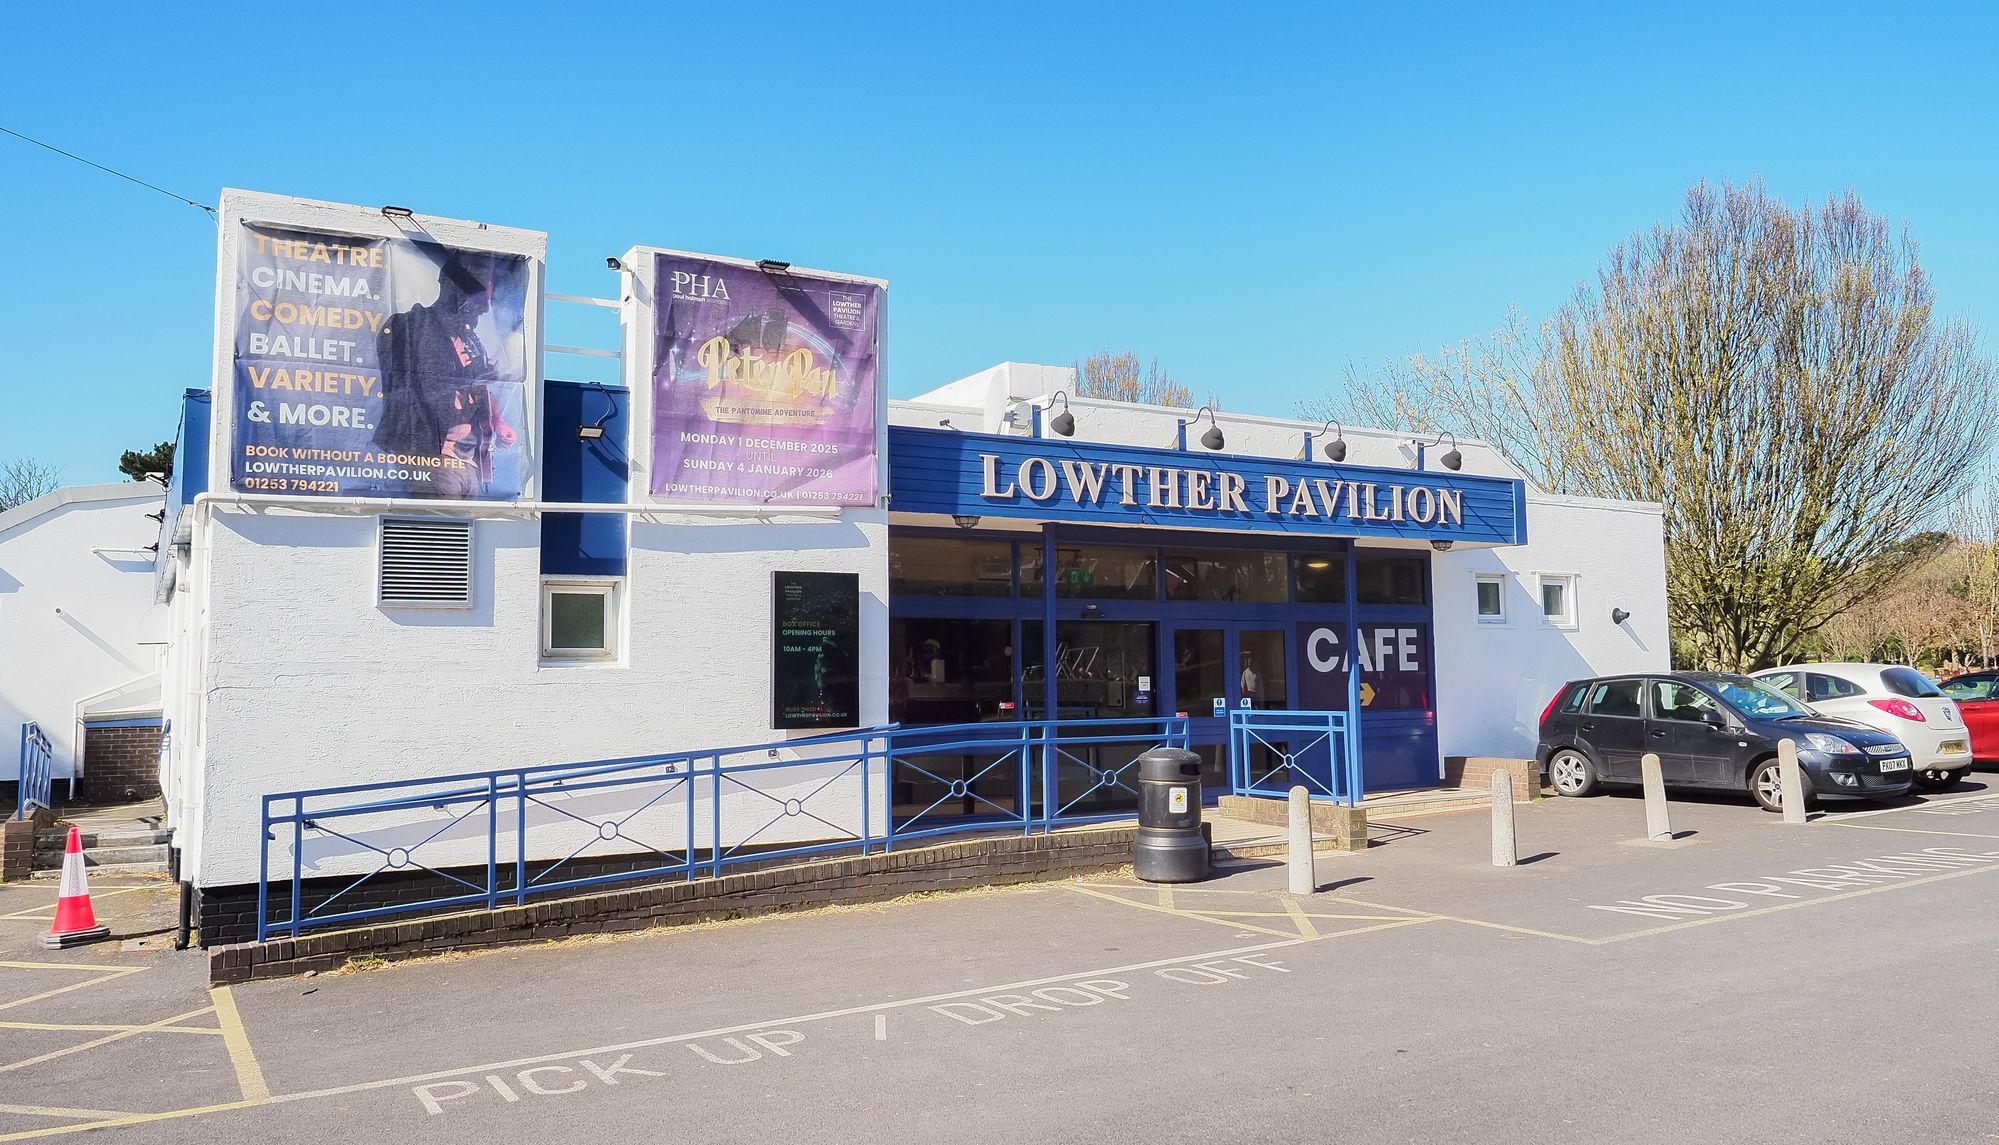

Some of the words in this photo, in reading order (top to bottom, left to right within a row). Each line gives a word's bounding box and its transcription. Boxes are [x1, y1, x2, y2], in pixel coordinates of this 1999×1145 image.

[252, 266, 380, 300] CINEMA.
[671, 270, 731, 300] PHA
[251, 300, 391, 334] COMEDY.
[833, 300, 862, 309] LOWTHER
[833, 307, 861, 315] PAVILION
[250, 333, 363, 363] BALLET.
[698, 336, 781, 391] Peter
[782, 347, 839, 400] Pan
[248, 367, 384, 398] VARIETY.
[247, 401, 271, 423] &
[280, 403, 374, 429] MORE.
[715, 406, 729, 415] THE
[731, 407, 772, 416] PANTOMIME
[775, 409, 815, 417] ADVENTURE
[680, 432, 735, 446] MONDAY
[738, 438, 742, 447] 1
[745, 438, 808, 452] DECEMBER
[811, 443, 838, 454] 2025
[245, 445, 288, 458] BOOK
[292, 448, 360, 462] WITHOUT
[364, 452, 374, 463] A
[378, 454, 441, 467] BOOKING
[444, 458, 465, 469] FEE
[683, 458, 734, 472] SUNDAY
[737, 463, 745, 473] 4
[748, 463, 804, 477] JANUARY
[806, 467, 833, 478] 2026
[746, 451, 776, 462] UNTIL
[245, 461, 431, 482] LOWTHERPAVILION.CO.UK
[244, 478, 287, 490] 01253
[291, 480, 339, 493] 794221
[665, 483, 793, 499] LOWTHERPAVILION.CO.UK
[802, 491, 829, 500] 01253
[978, 453, 1250, 513] LOWTHER
[1264, 474, 1463, 526] PAVILION
[798, 620, 821, 628] OFFICE
[1307, 627, 1419, 674] CAFE
[1586, 894, 1750, 920] NO
[1705, 847, 1999, 899] PARKING
[410, 1054, 667, 1114] PICK
[686, 1030, 807, 1064] UP
[926, 978, 1131, 1026] DROP
[1153, 953, 1292, 985] OFF
